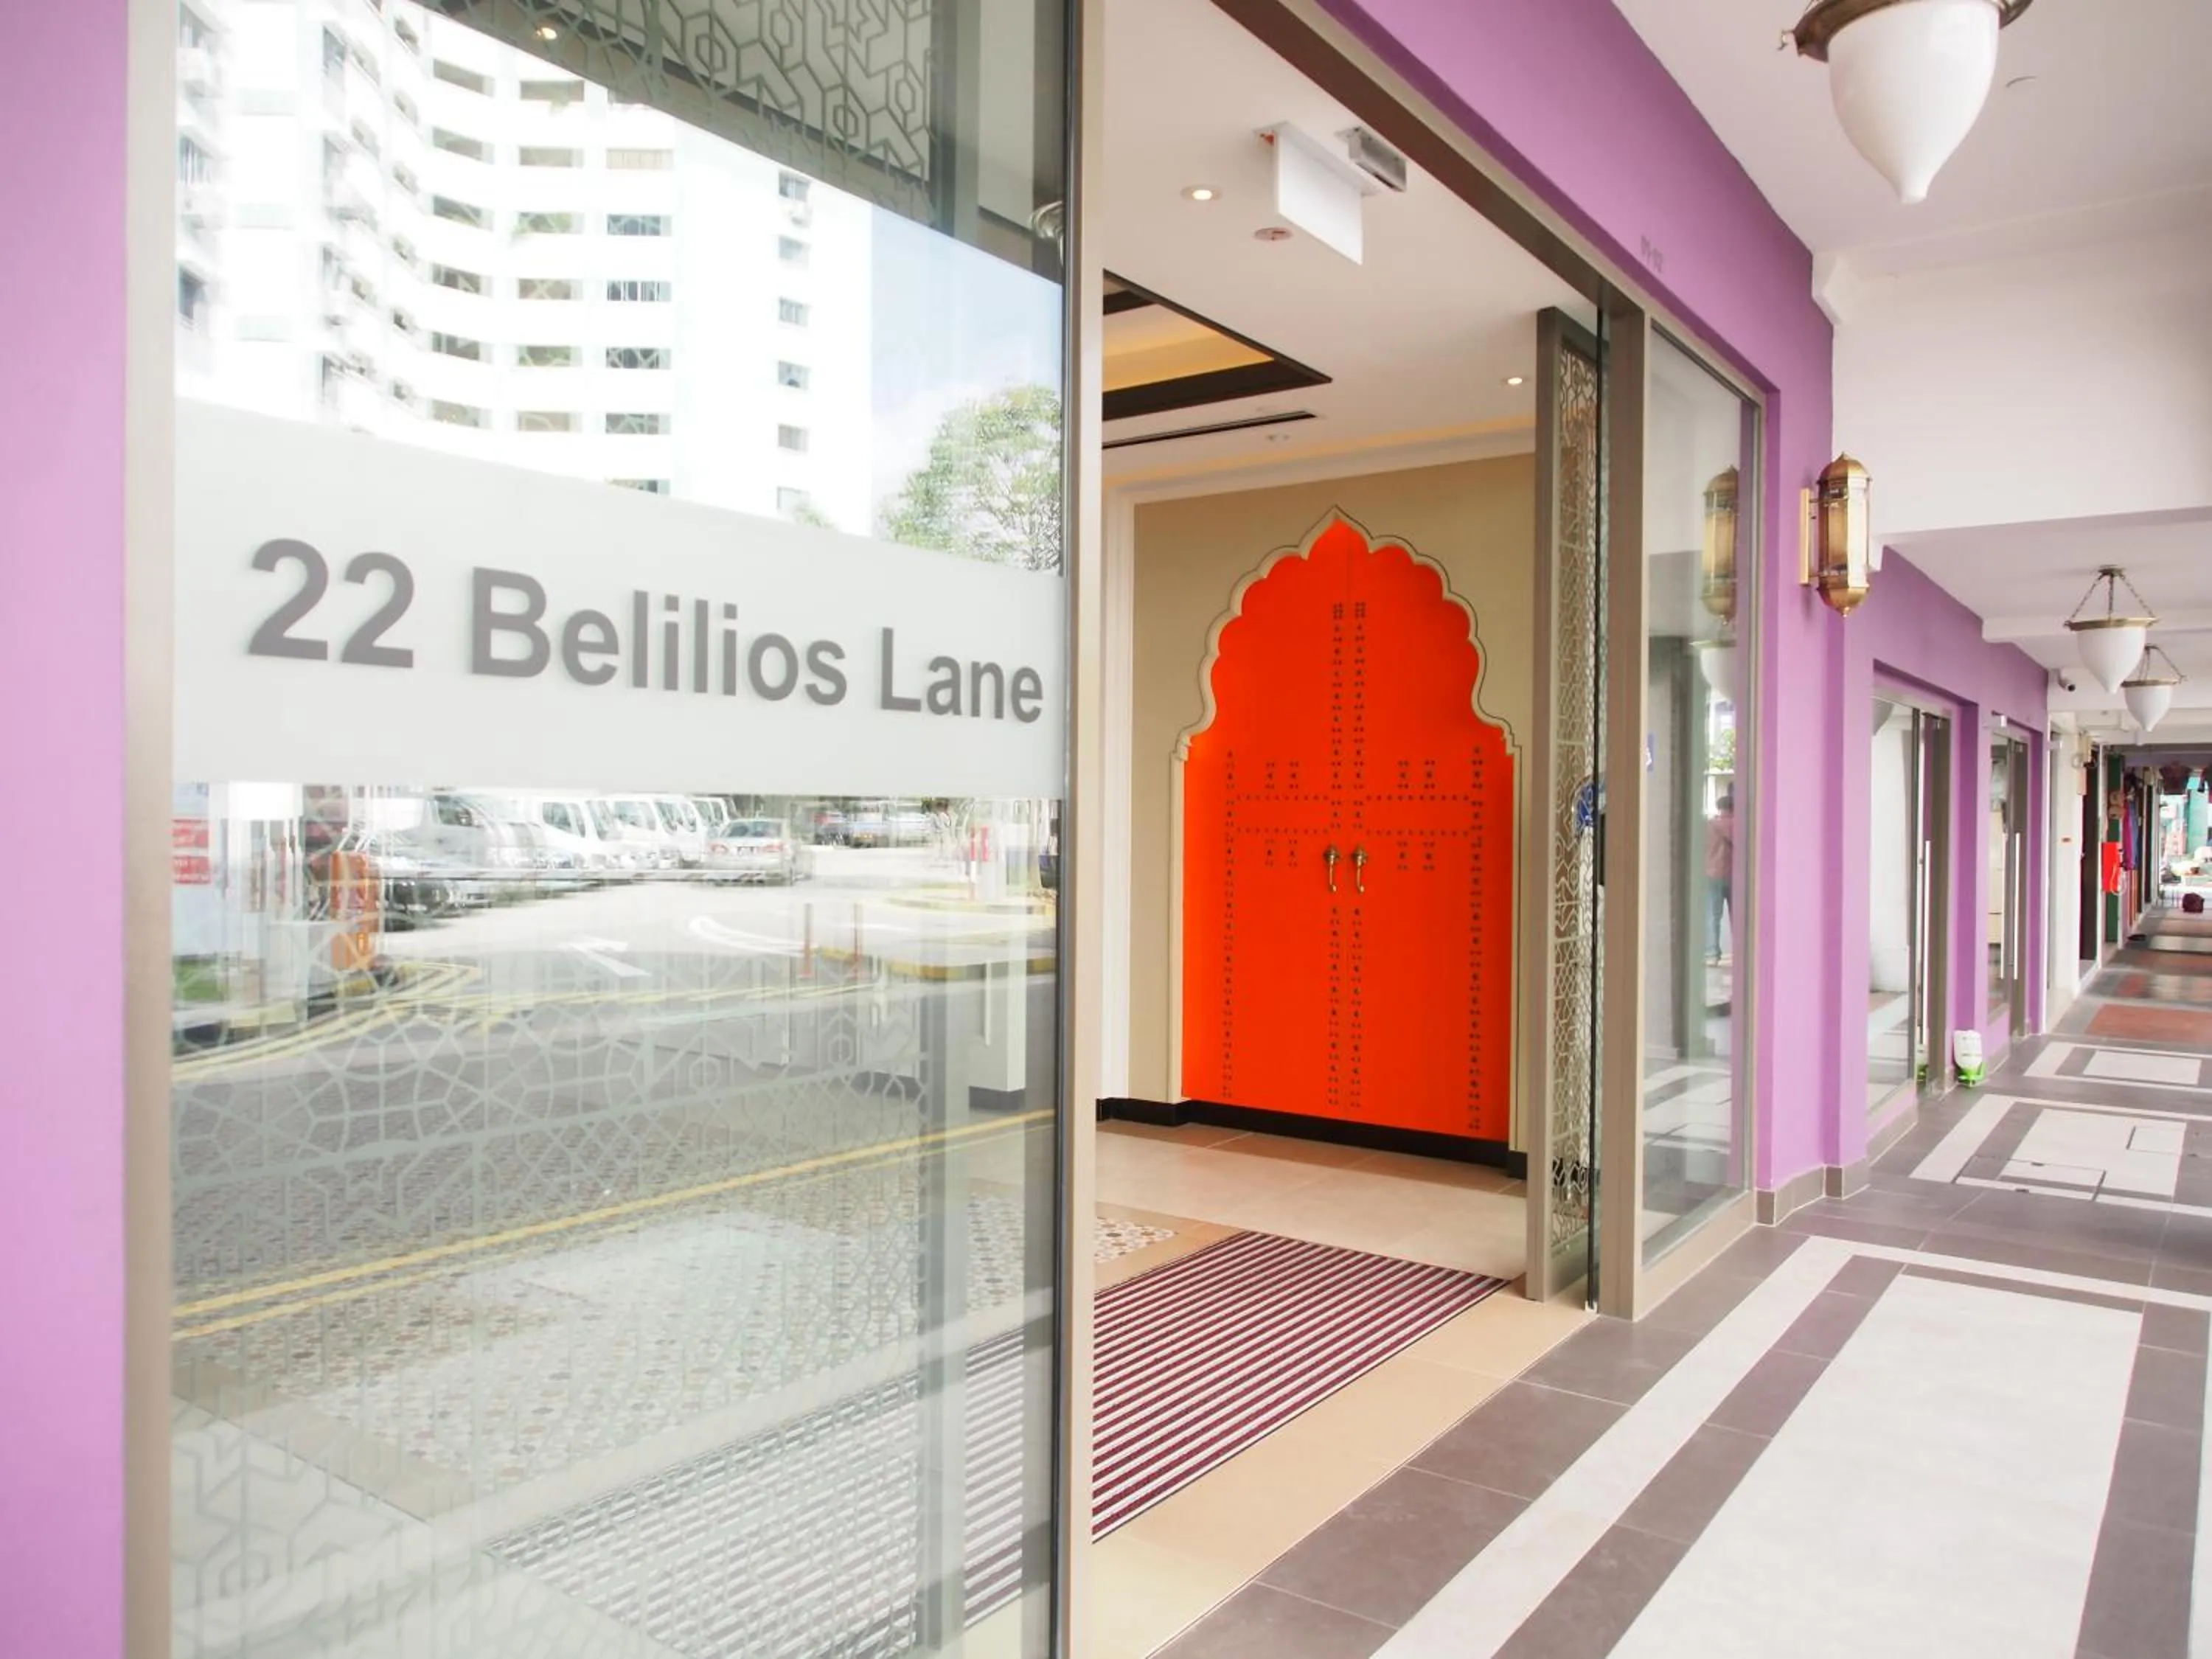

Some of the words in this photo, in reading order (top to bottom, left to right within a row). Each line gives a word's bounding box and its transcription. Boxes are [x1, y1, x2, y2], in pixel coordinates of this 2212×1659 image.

[248, 538, 414, 669] 22
[470, 568, 847, 706] Belilios
[880, 627, 1043, 724] Lane
